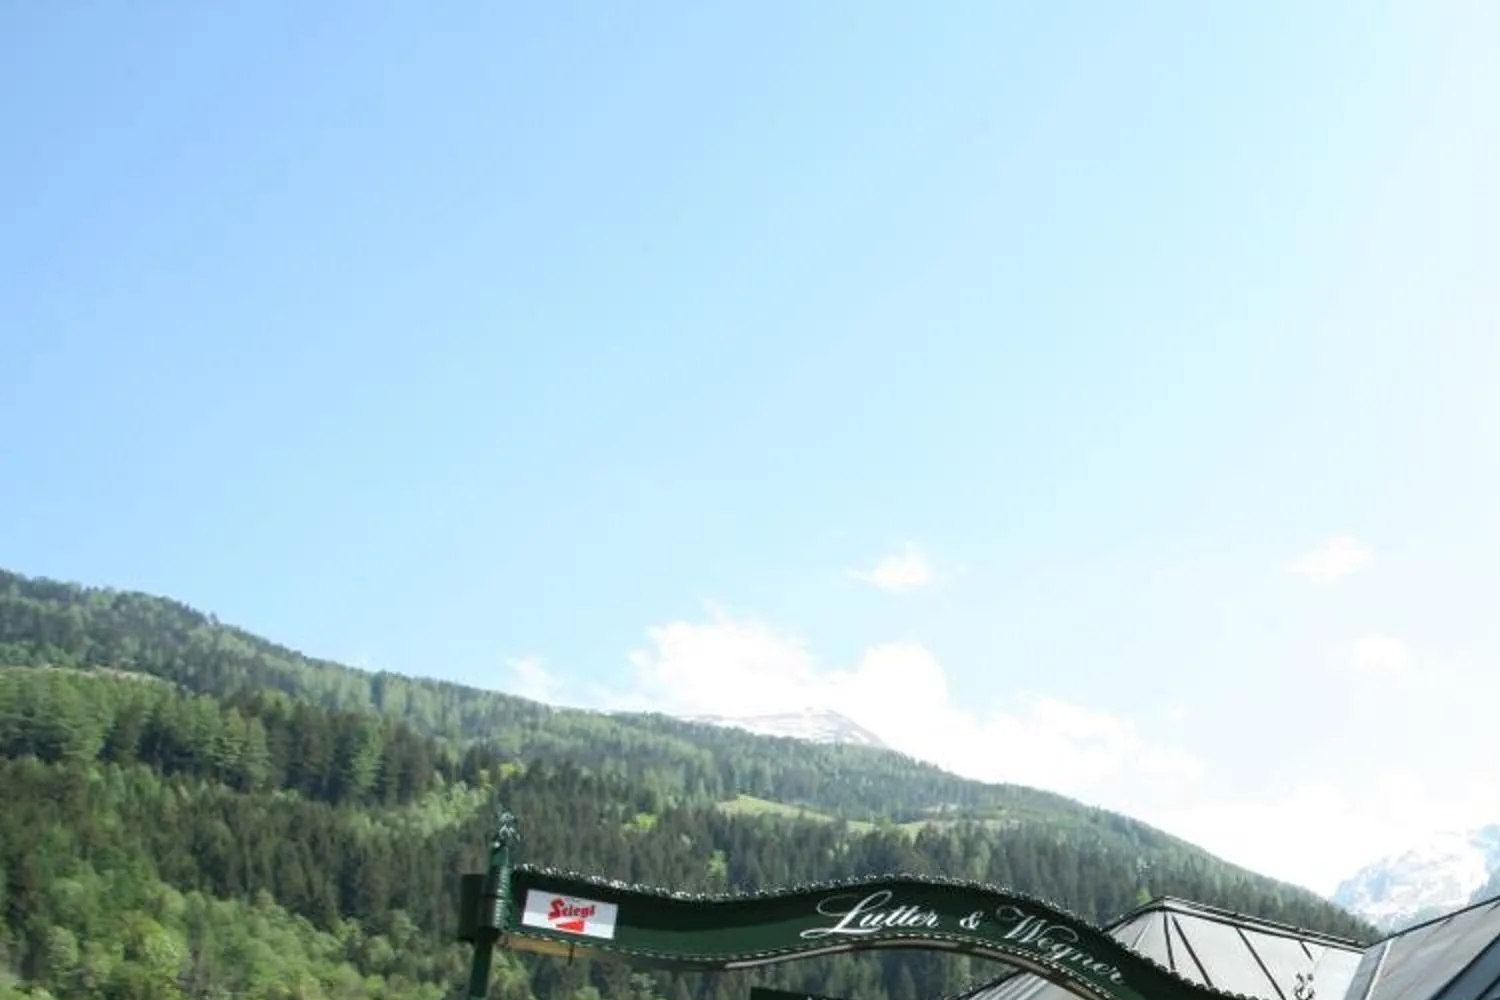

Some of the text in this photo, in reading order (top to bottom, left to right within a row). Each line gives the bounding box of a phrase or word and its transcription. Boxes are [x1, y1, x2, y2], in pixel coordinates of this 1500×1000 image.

[800, 889, 1125, 985] Lutter & Wegner
